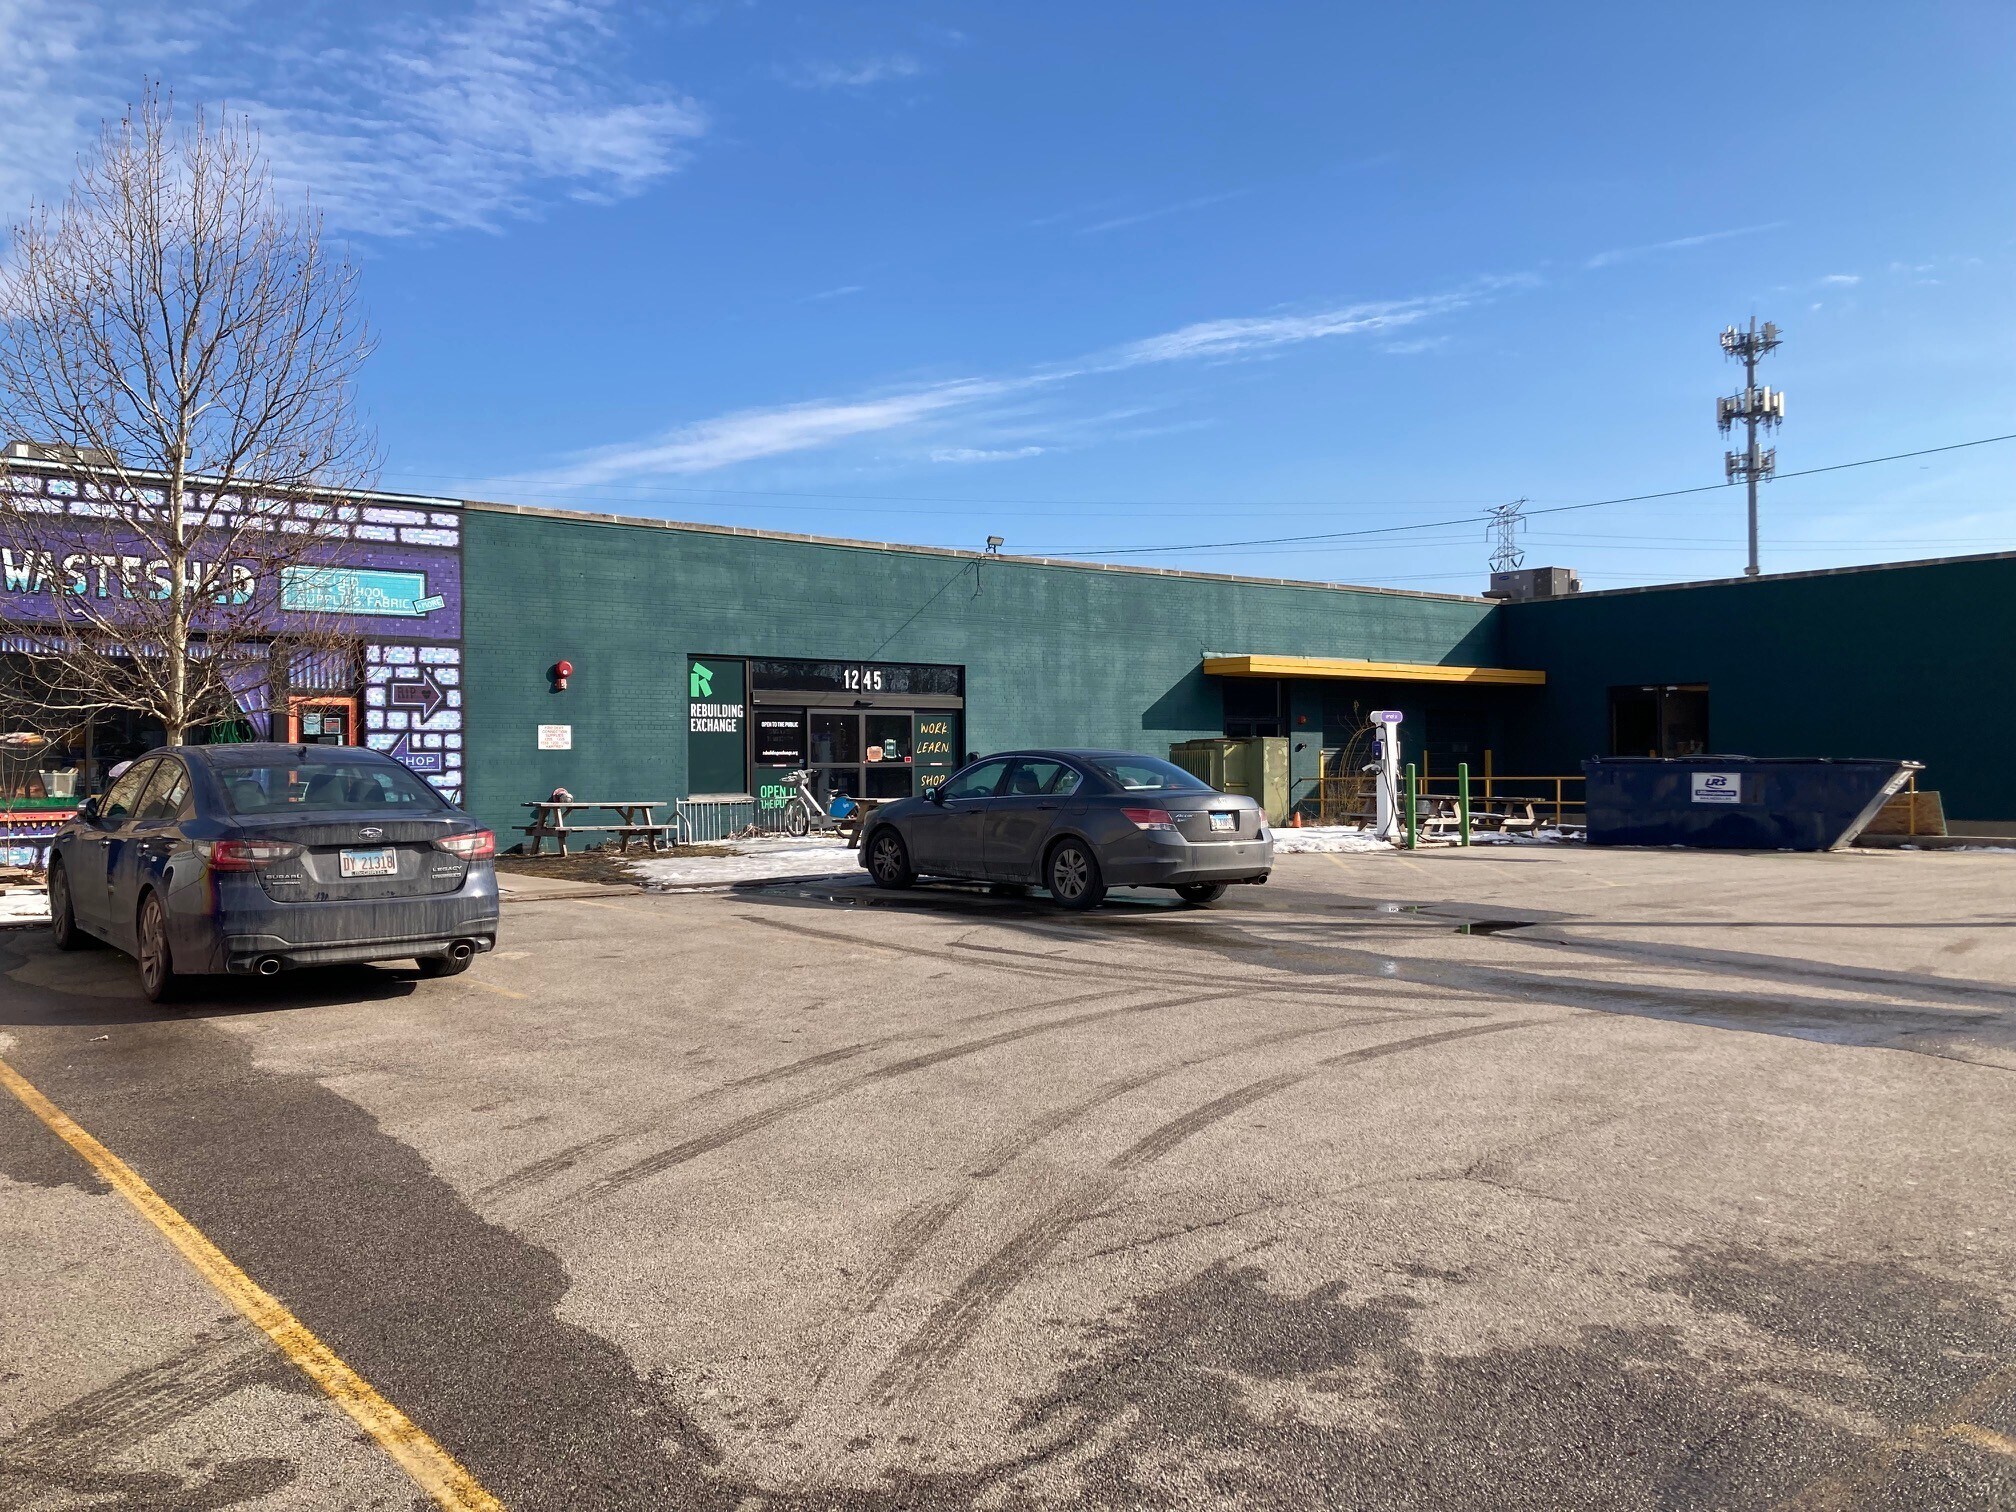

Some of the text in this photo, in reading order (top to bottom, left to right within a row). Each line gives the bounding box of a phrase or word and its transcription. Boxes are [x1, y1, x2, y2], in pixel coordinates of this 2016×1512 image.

[1, 549, 255, 605] WASTESHED
[338, 587, 386, 600] SCHOOL
[367, 598, 410, 609] FABRIC
[422, 600, 442, 610] MORE
[843, 669, 882, 690] 1245
[690, 703, 744, 718] REBUILDING
[690, 718, 737, 732] EXCHANGE
[760, 785, 786, 798] OPEN
